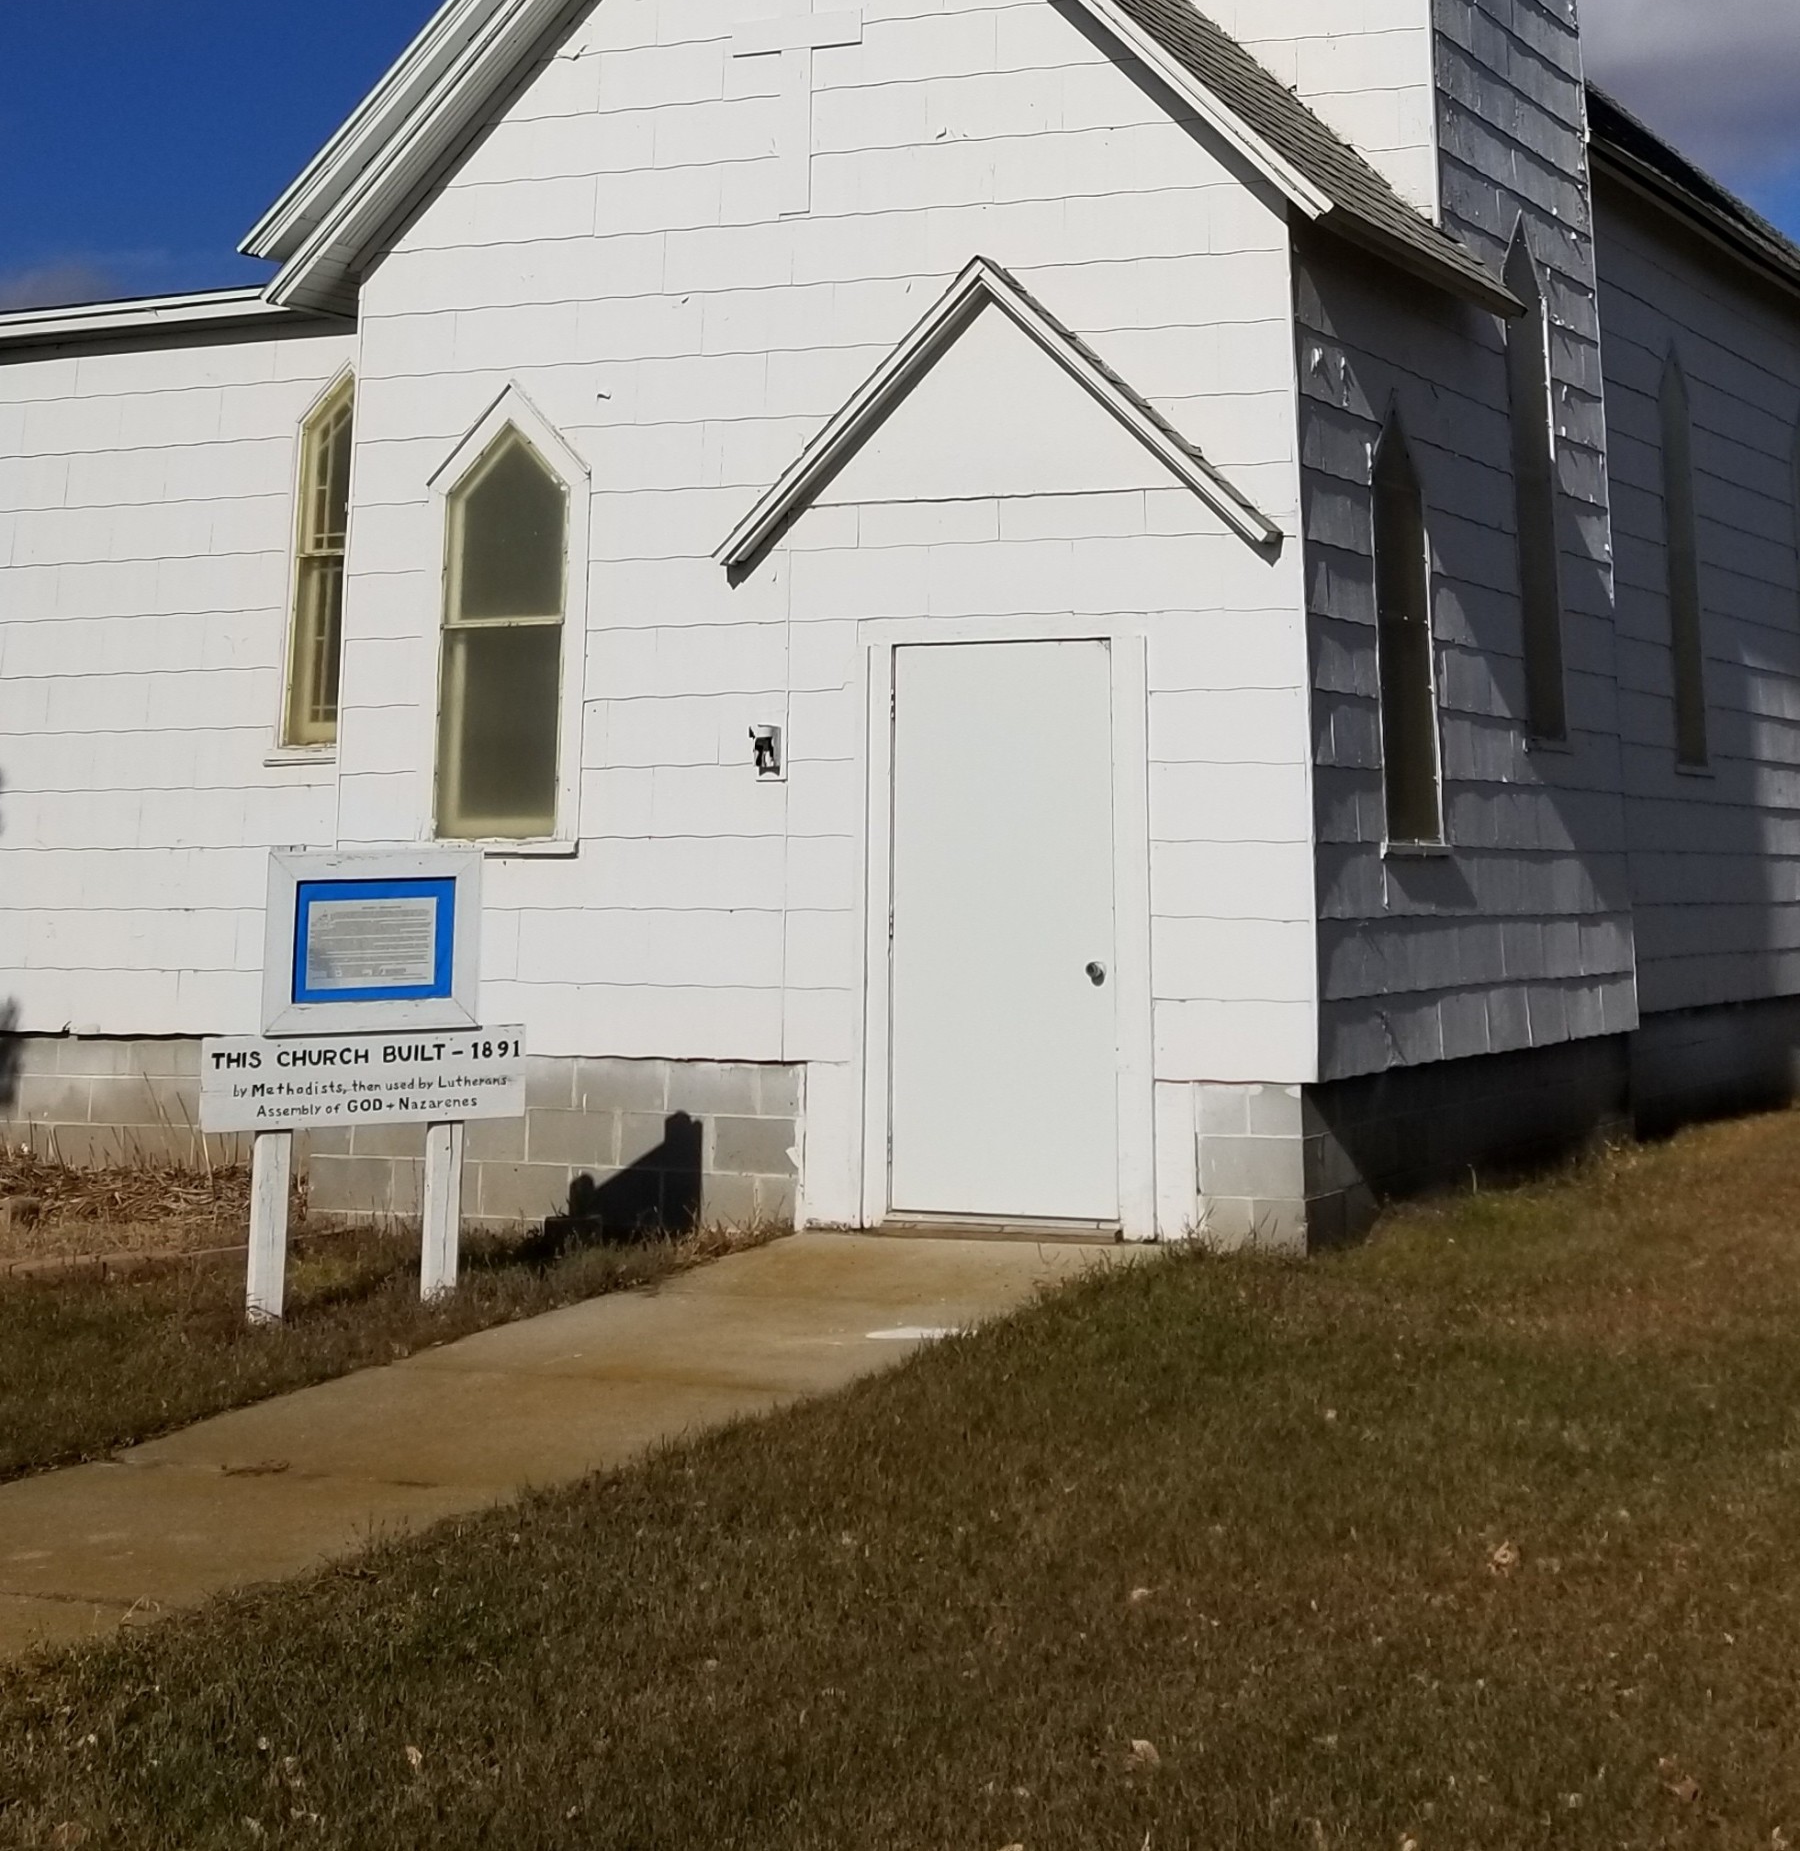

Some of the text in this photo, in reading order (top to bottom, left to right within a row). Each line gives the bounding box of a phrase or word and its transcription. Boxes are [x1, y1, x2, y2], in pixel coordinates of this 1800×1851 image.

[211, 1050, 262, 1070] THIS
[276, 1047, 369, 1067] CHURCH
[382, 1043, 446, 1063] BUILT
[470, 1040, 520, 1060] 1891
[232, 1075, 508, 1098] by Methodists, then used by Lutherans
[256, 1103, 322, 1118] Assembly
[325, 1102, 341, 1115] of
[347, 1098, 383, 1113] GOD
[399, 1097, 478, 1111] Nazarenes
